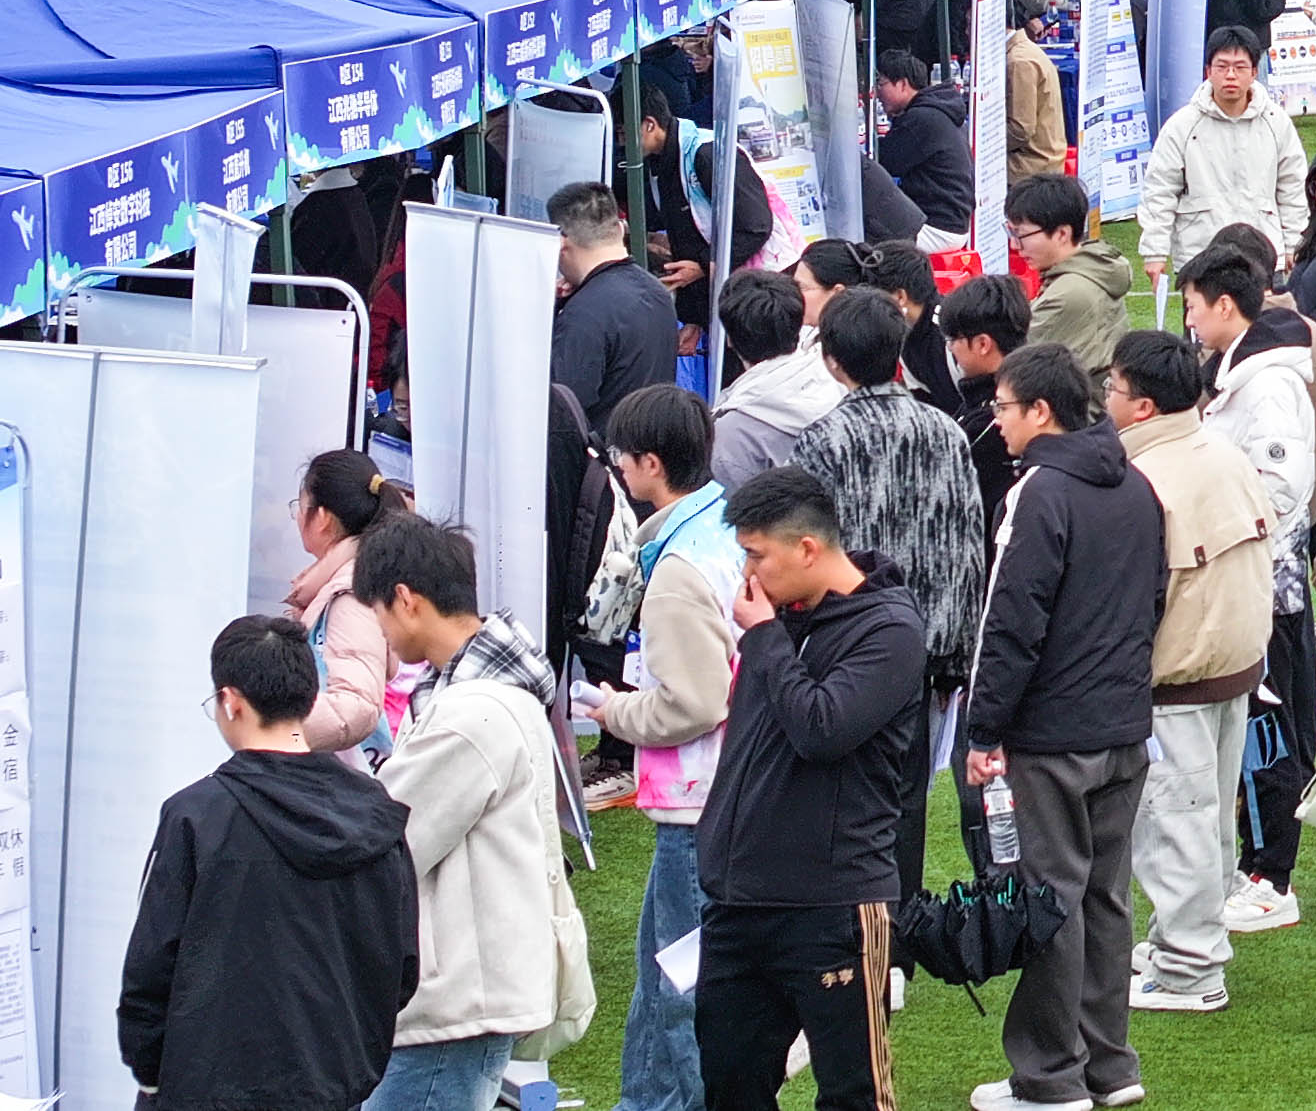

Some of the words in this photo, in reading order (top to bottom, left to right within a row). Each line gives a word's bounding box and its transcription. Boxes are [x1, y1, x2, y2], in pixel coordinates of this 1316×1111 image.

[340, 124, 370, 154] 有限公司
[121, 160, 133, 185] 156
[105, 230, 137, 266] 有限公司
